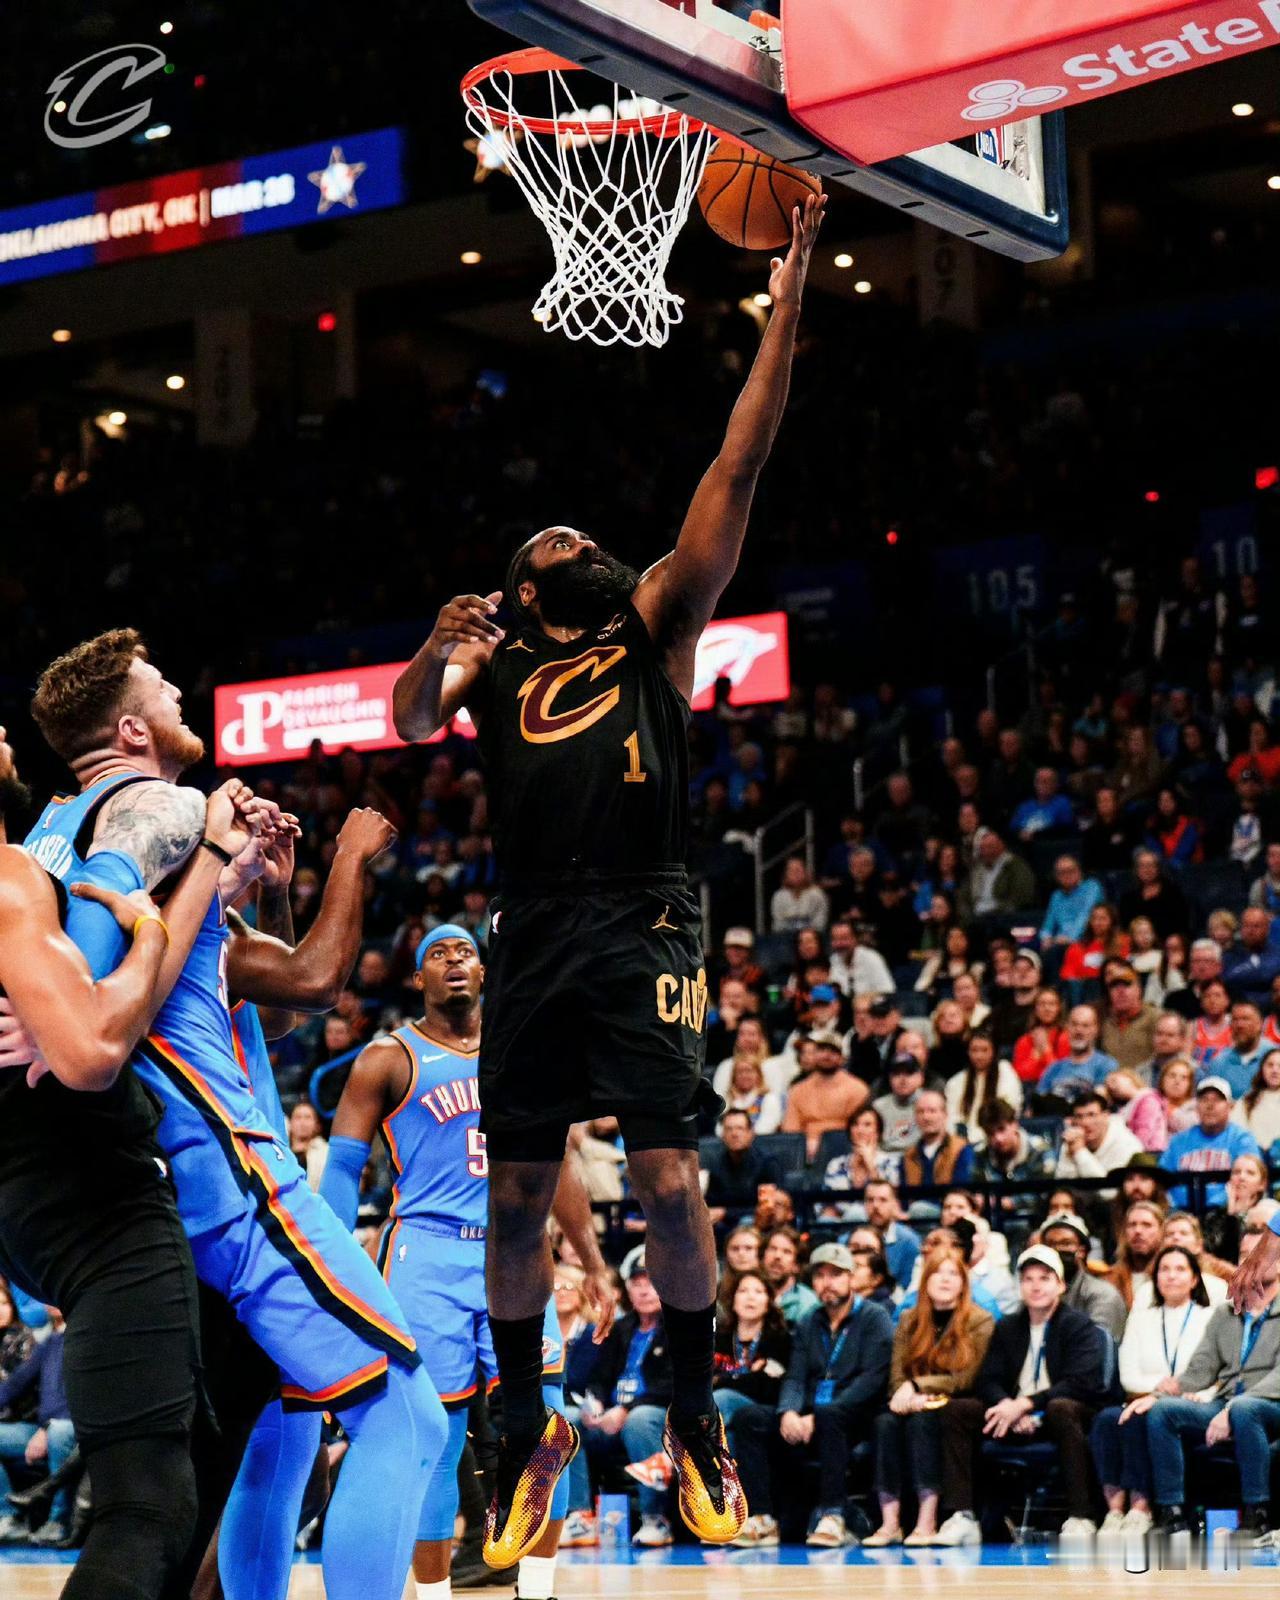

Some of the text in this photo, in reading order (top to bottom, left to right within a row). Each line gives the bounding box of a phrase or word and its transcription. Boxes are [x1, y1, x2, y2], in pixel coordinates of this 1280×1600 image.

[1062, 17, 1264, 91] State
[965, 562, 1040, 617] 105
[623, 729, 647, 783] 1
[465, 1127, 490, 1178] 5
